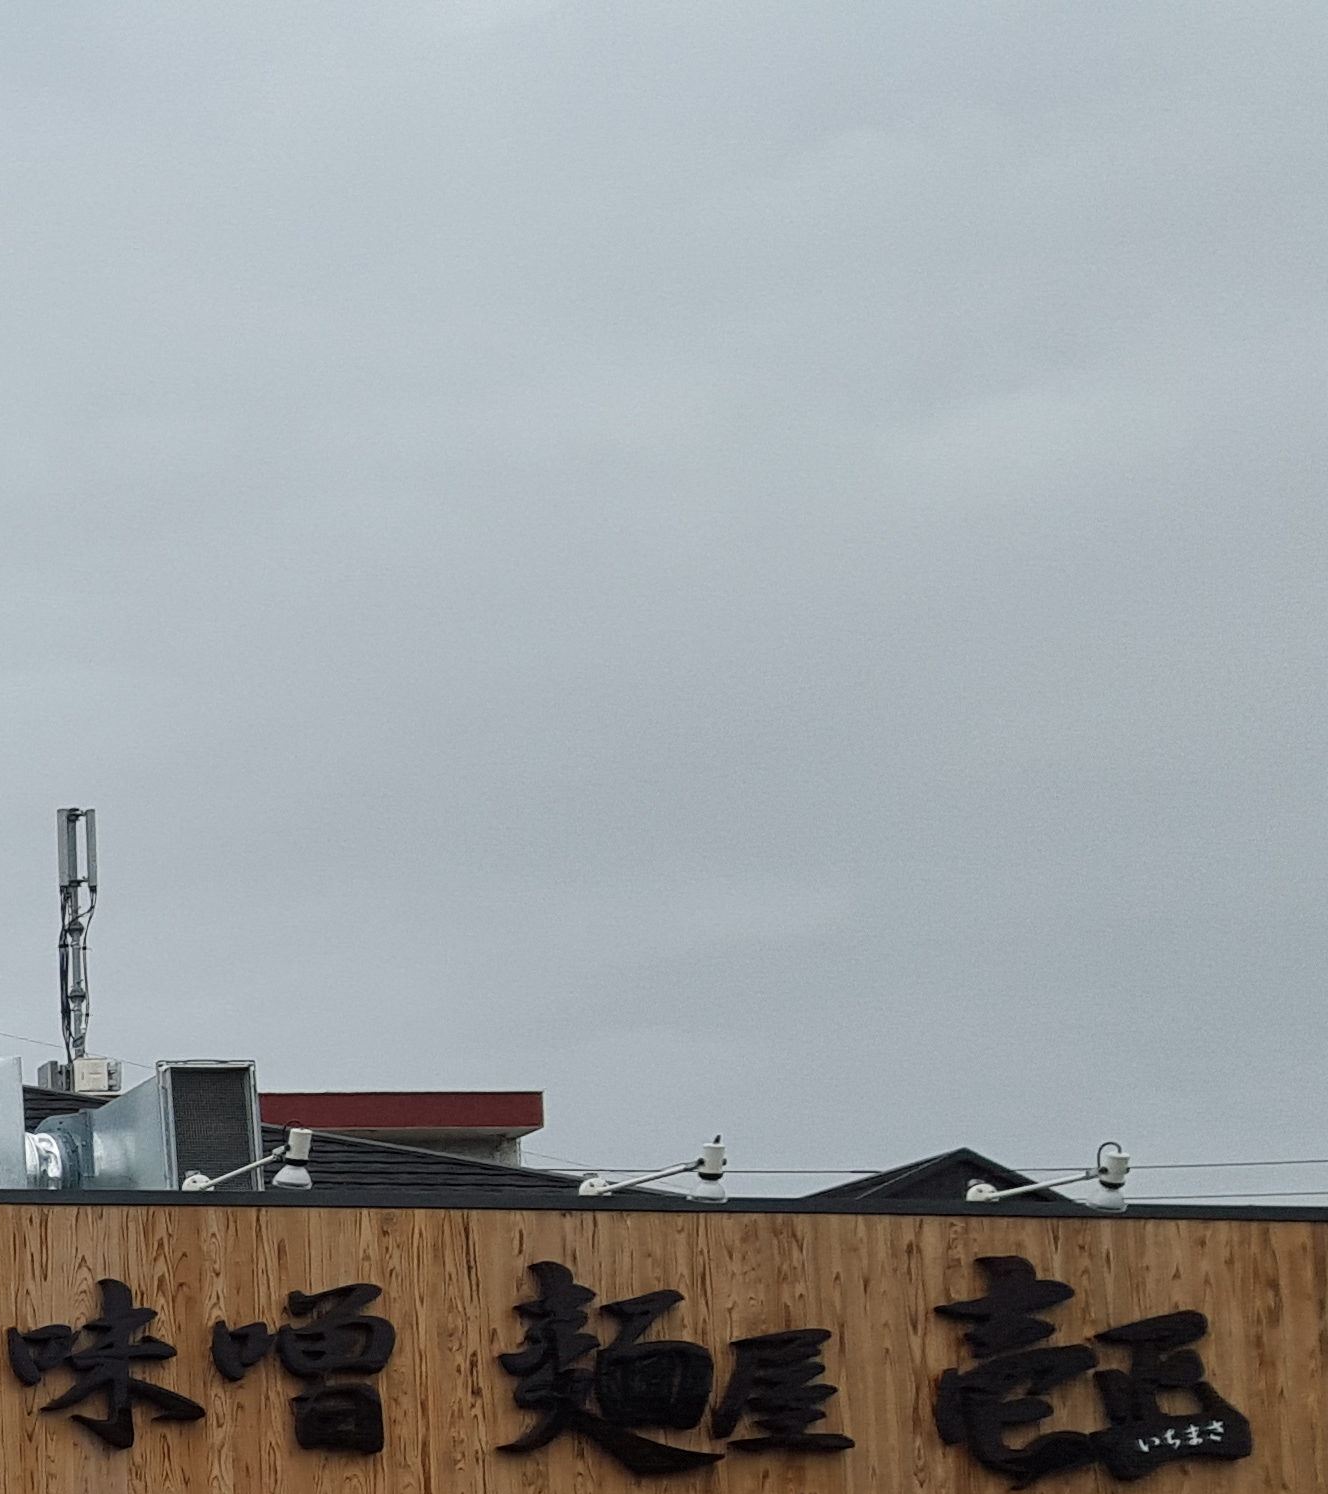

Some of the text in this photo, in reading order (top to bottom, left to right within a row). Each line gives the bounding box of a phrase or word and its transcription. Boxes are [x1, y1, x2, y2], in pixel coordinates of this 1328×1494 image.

[496, 1260, 856, 1476] 麺屋
[1137, 1420, 1225, 1453] いちまさ
